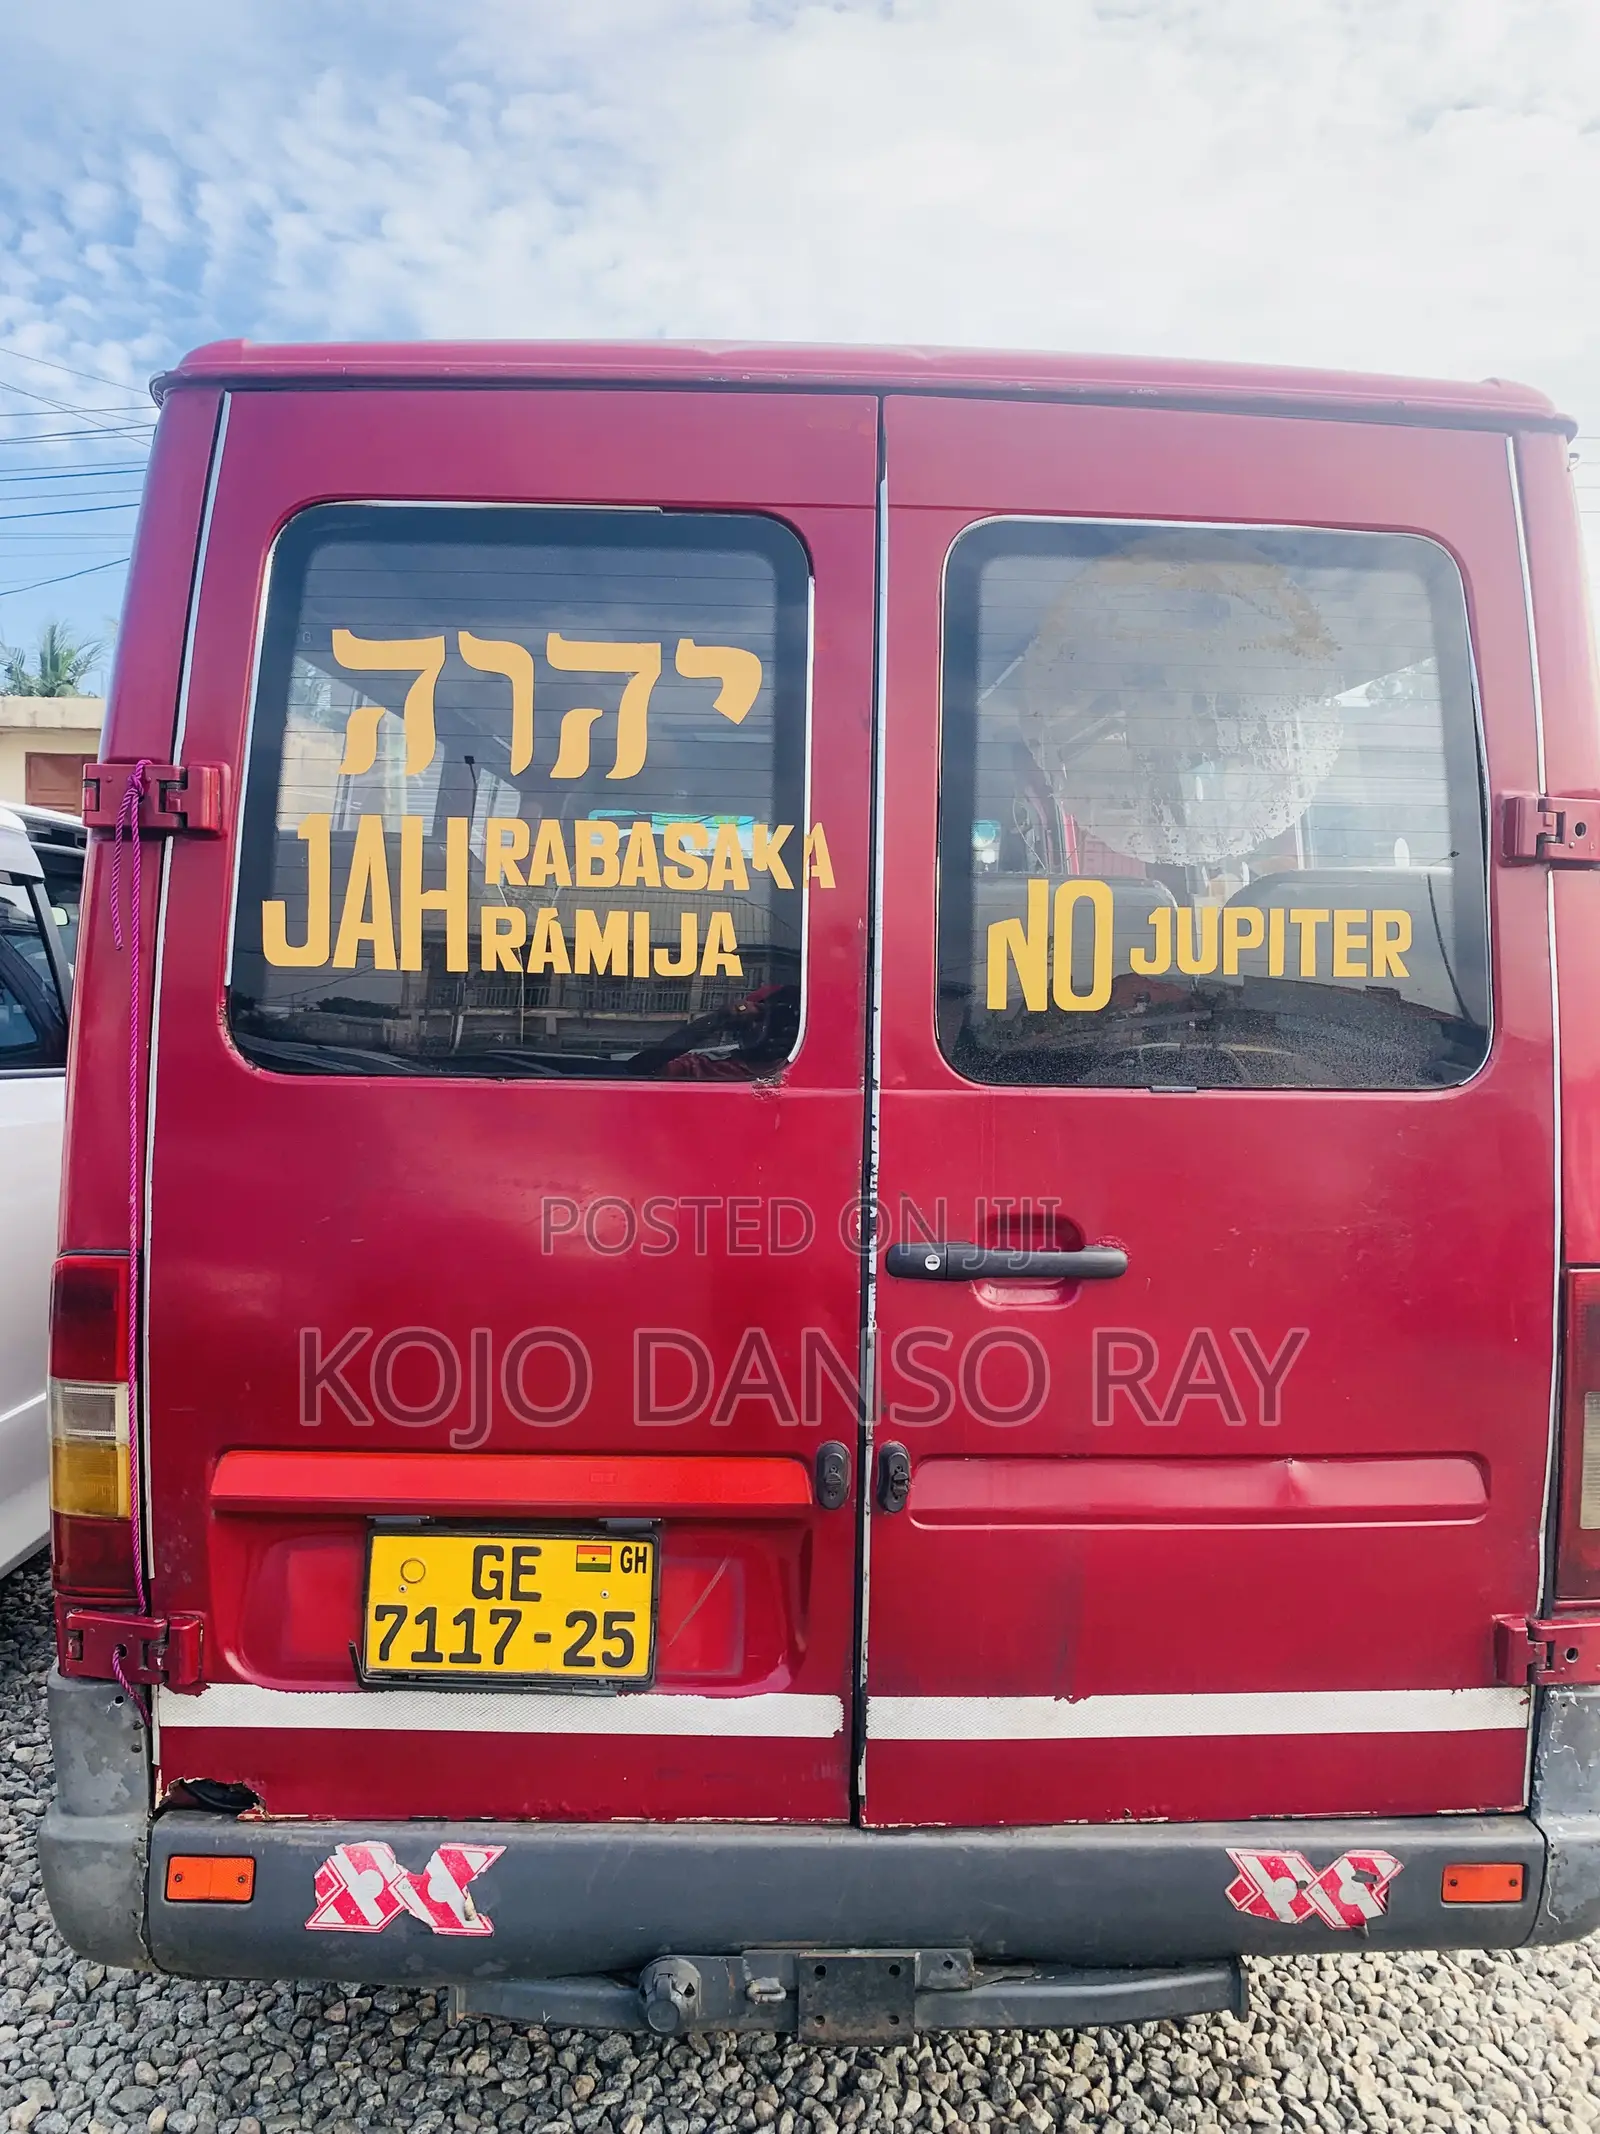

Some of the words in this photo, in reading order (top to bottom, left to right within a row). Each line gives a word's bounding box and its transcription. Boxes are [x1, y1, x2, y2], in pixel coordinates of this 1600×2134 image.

[485, 817, 837, 892] RABASAKA
[262, 812, 469, 972] JAH
[480, 905, 744, 978] RAMIJA
[986, 878, 1114, 1013] NO
[1129, 906, 1412, 978] JUPITER
[471, 1544, 543, 1602] GE
[619, 1545, 648, 1575] GH
[374, 1604, 636, 1668] 7117-25
